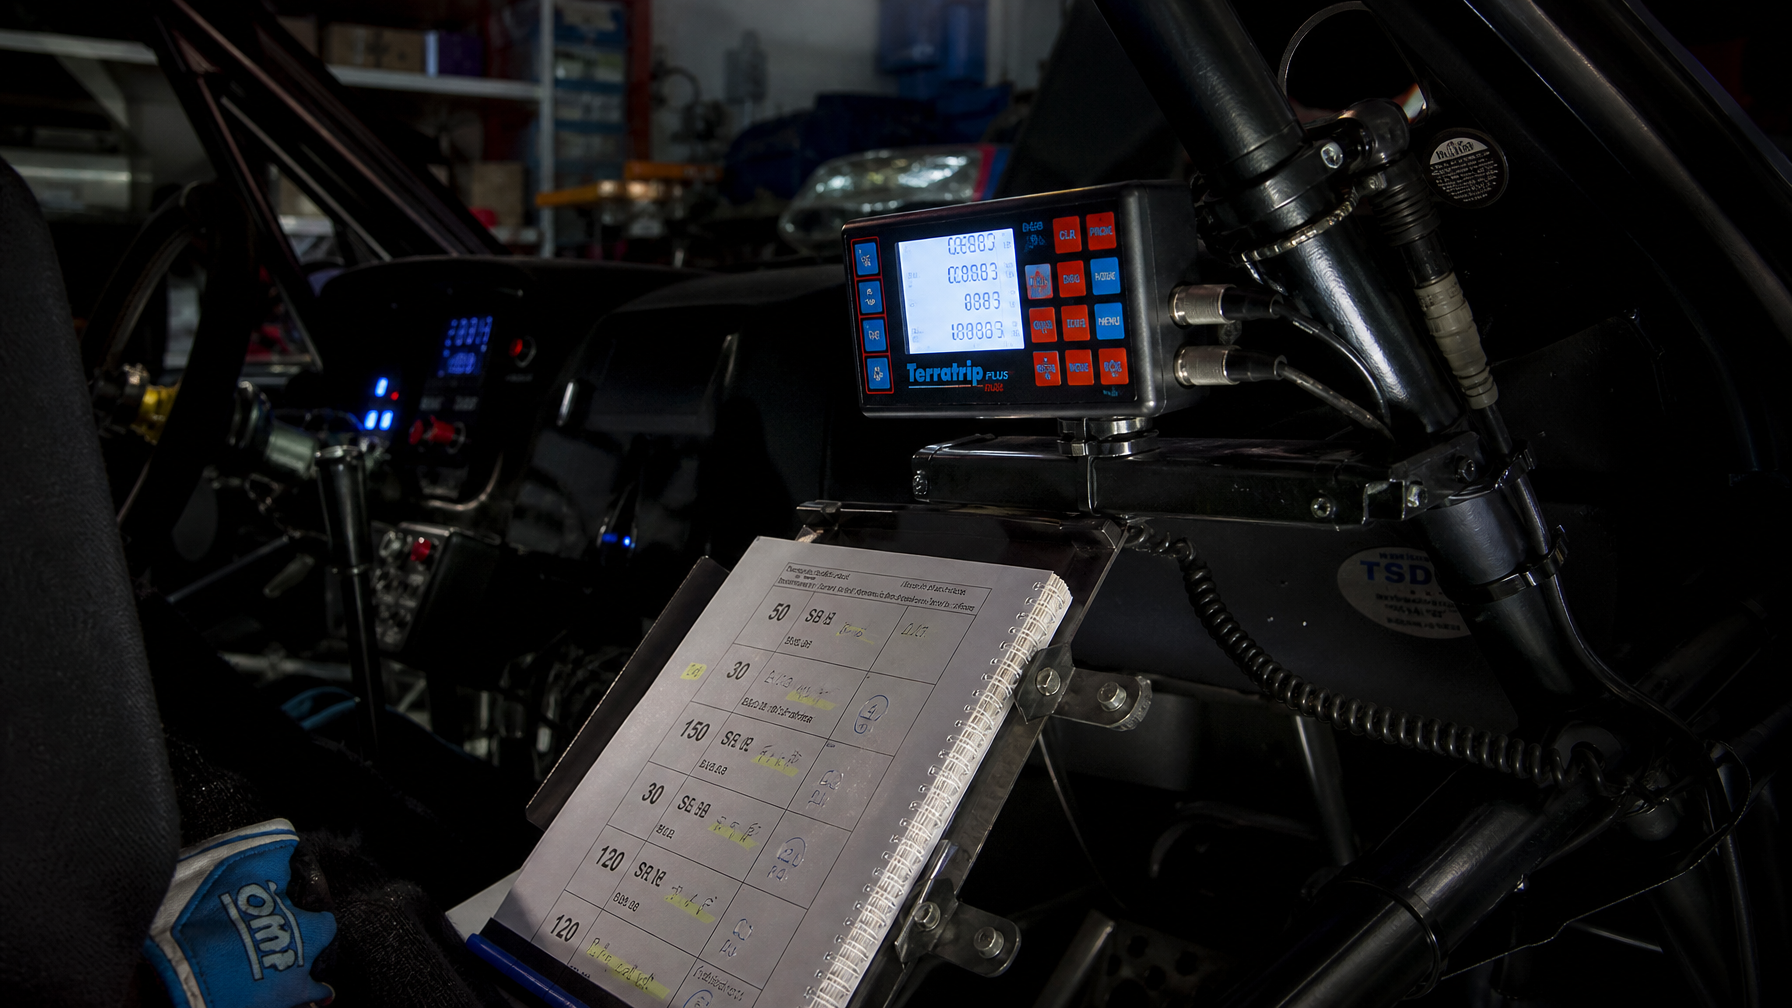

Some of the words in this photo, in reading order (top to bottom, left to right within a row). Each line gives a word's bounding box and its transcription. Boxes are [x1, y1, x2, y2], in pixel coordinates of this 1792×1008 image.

[1059, 229, 1076, 241] CLR
[906, 360, 984, 386] Terratrip
[1360, 560, 1432, 585] TSD
[768, 602, 791, 621] 50
[726, 661, 751, 680] 30
[680, 719, 711, 742] 150
[641, 782, 665, 805] 30
[595, 845, 625, 872] 120
[550, 914, 580, 943] 120
